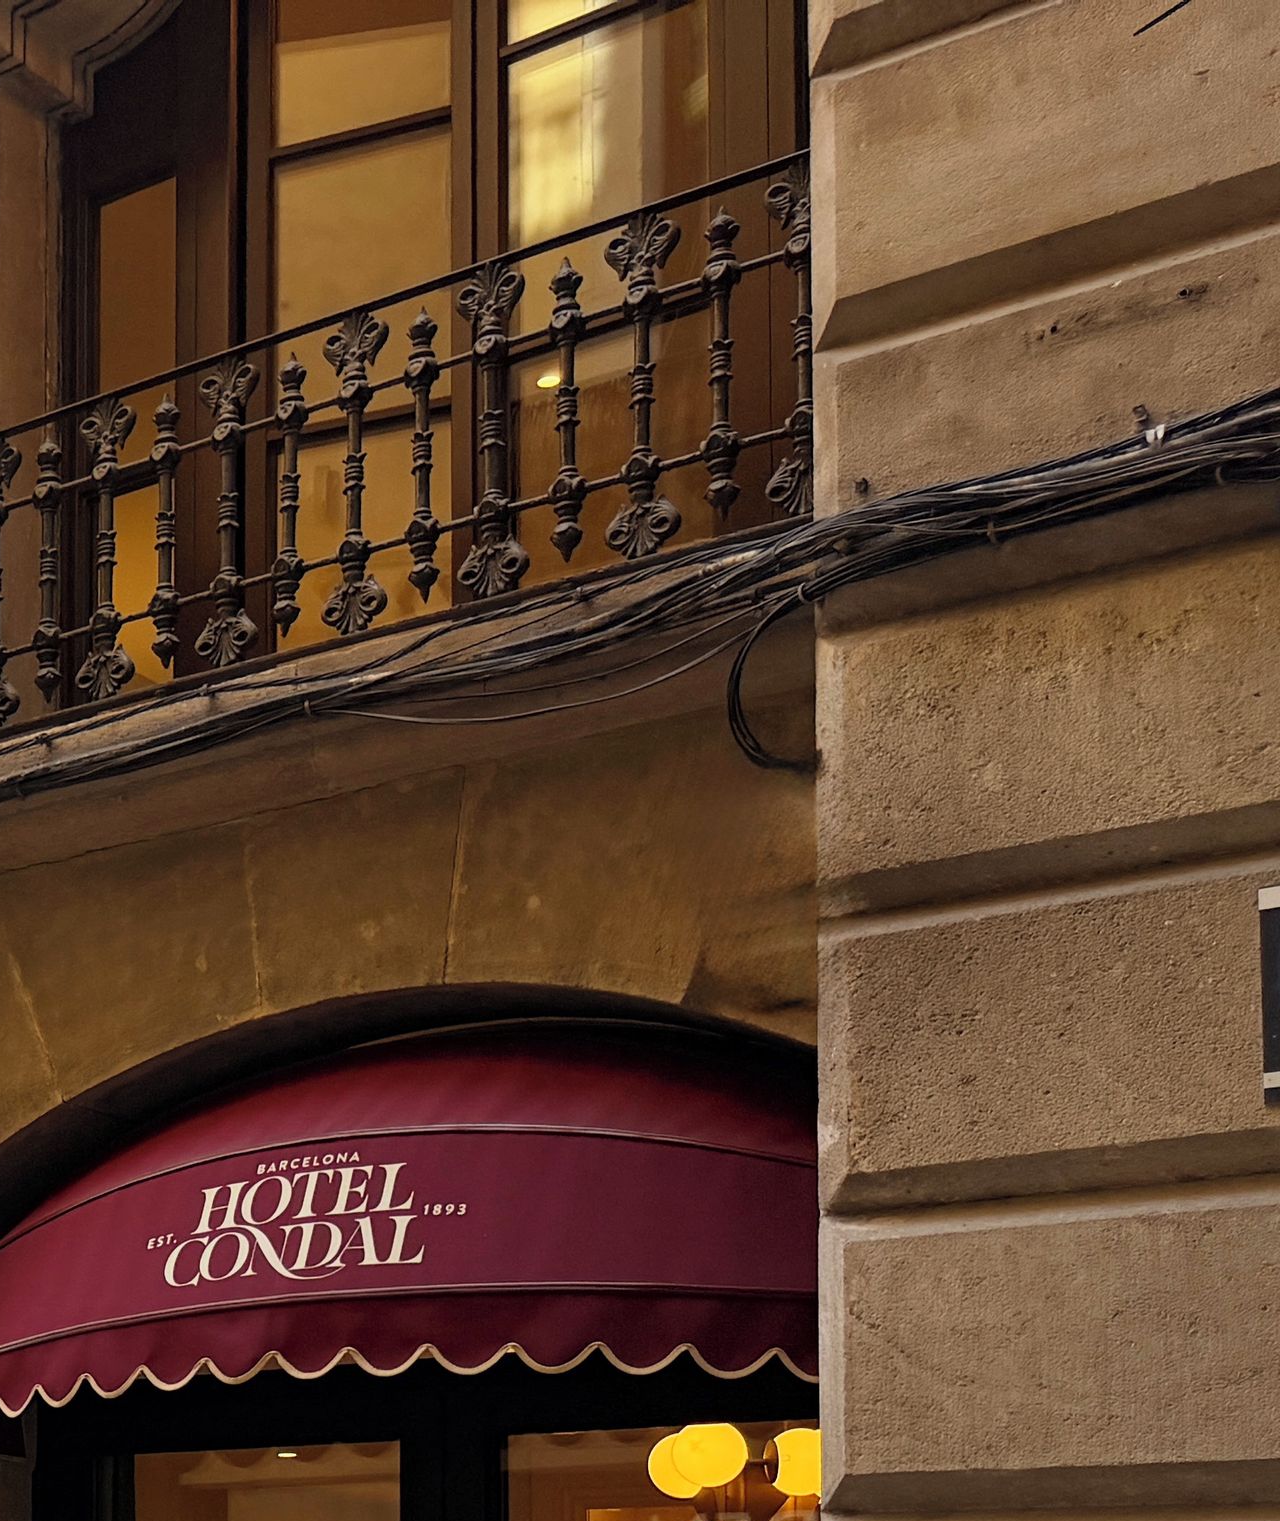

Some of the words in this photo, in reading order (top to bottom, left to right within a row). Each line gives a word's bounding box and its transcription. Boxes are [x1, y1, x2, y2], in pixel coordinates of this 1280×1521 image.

[256, 1151, 361, 1175] BARCELONA
[190, 1162, 415, 1235] HOTEL
[422, 1203, 468, 1216] 1893
[146, 1233, 177, 1250] EST.
[163, 1215, 425, 1287] CONDAL
